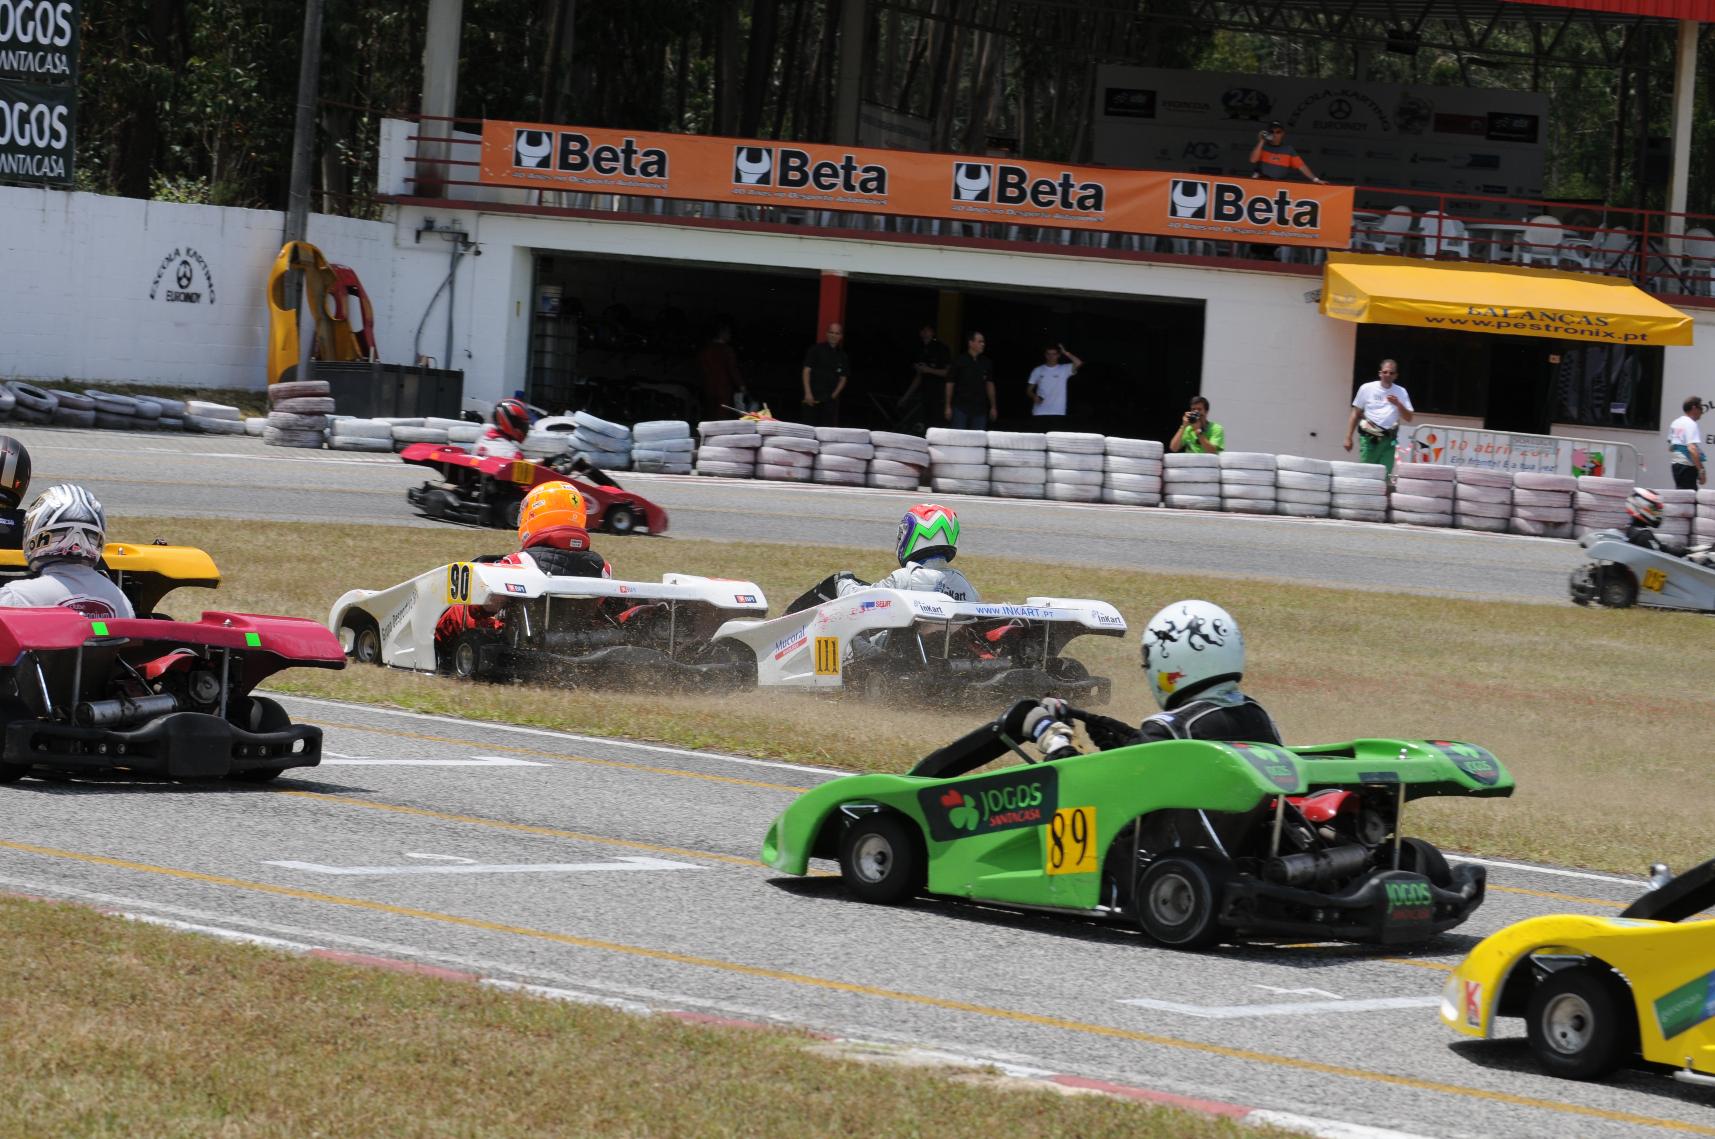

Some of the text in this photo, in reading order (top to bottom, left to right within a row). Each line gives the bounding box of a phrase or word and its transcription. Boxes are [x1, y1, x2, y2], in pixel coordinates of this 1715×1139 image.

[0, 0, 73, 47] OGOS
[0, 50, 70, 75] ANTACASA
[0, 101, 68, 150] OGOS
[0, 153, 65, 178] ANTACASA
[558, 131, 669, 179] Beta
[778, 148, 888, 195] Beta
[996, 164, 1106, 213] Beta
[1213, 182, 1320, 230] Beta
[1424, 315, 1649, 342] www.pestronix.pt
[1450, 439, 1468, 450] 10
[450, 563, 470, 602] 90
[817, 639, 838, 673] 111
[980, 783, 1043, 820] JOGOS
[1051, 809, 1088, 869] 89
[1384, 883, 1431, 914] JOGOS
